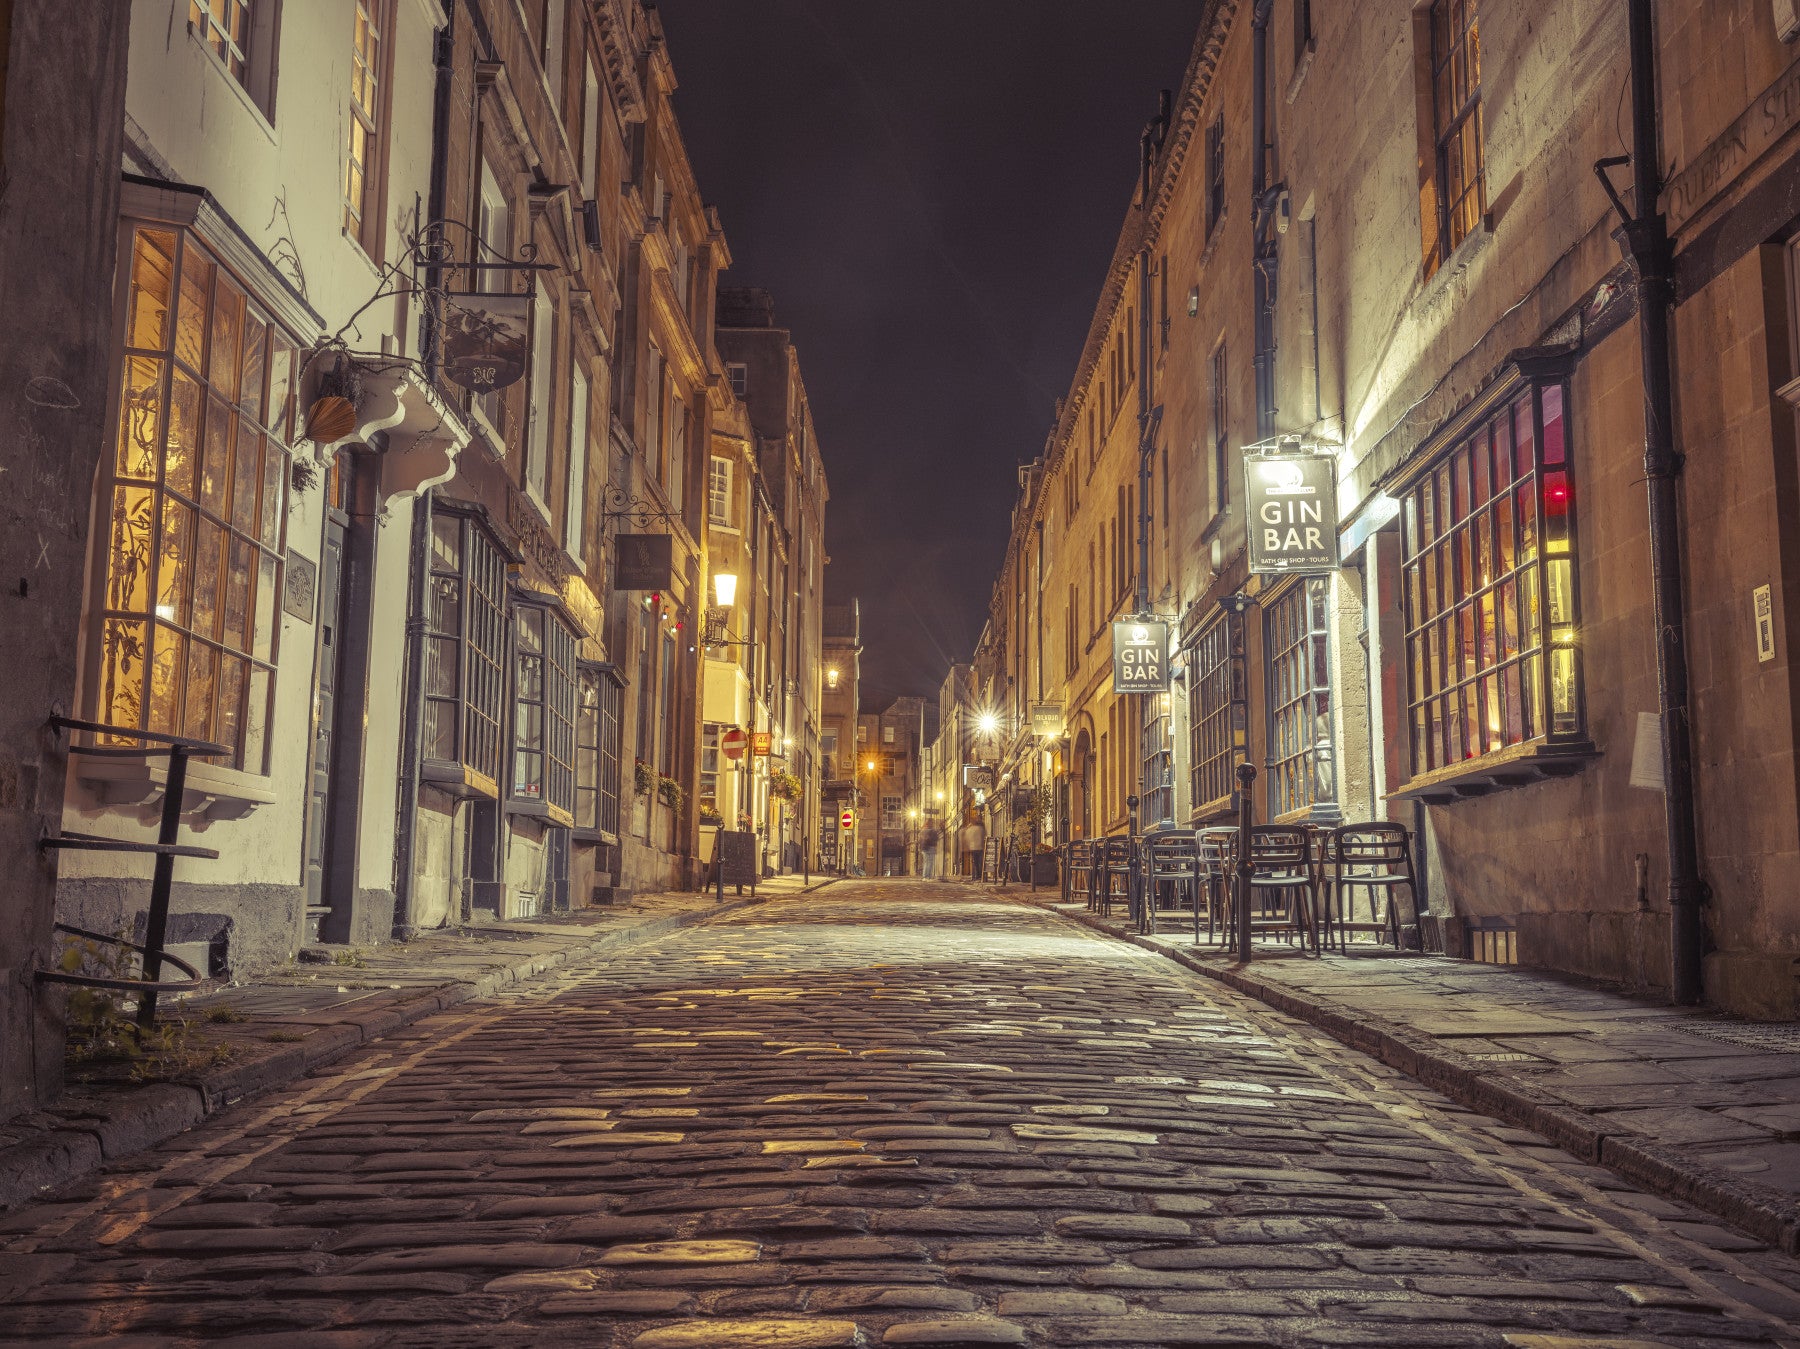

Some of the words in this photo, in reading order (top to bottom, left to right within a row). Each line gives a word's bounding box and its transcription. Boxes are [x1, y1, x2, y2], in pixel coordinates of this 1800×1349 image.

[1668, 124, 1748, 221] QUEEN
[1763, 77, 1800, 138] ST
[1260, 500, 1322, 524] GIN
[1264, 527, 1325, 551] BAR
[1121, 649, 1159, 664] GIN
[1123, 665, 1160, 680] BAR
